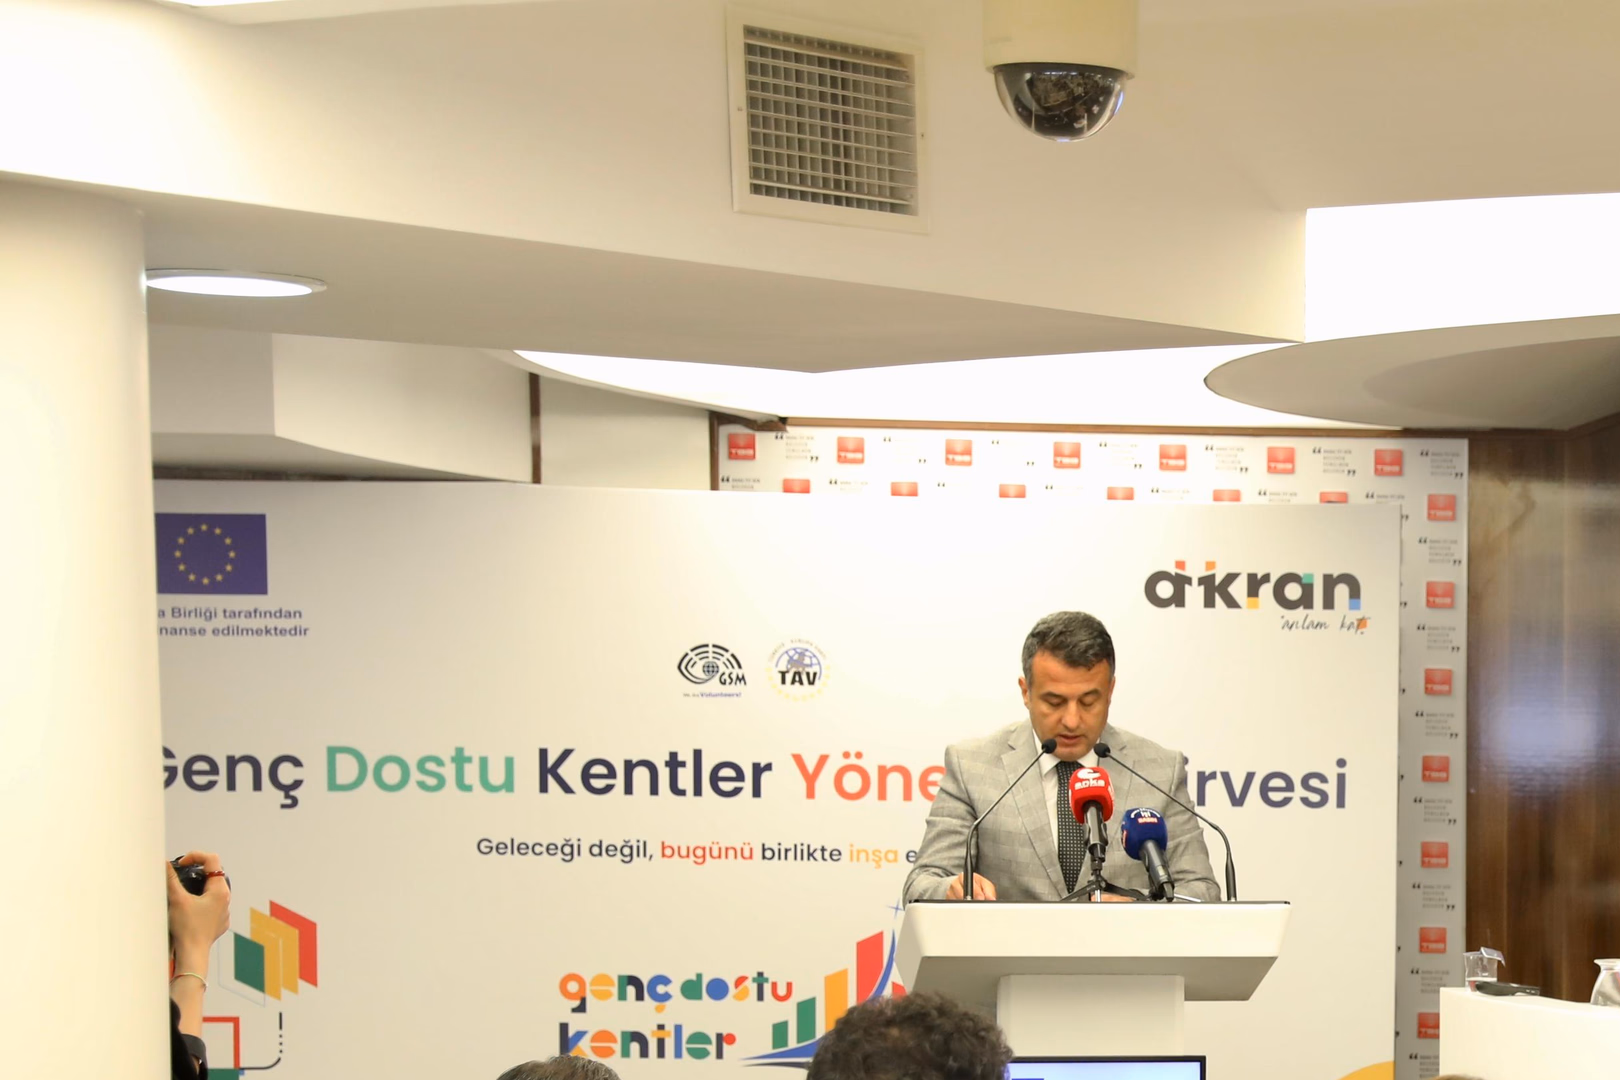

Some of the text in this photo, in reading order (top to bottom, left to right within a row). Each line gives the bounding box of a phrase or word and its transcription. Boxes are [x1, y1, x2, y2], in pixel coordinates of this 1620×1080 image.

[1144, 560, 1361, 611] akran
[159, 625, 310, 637] nanse edilmektedir
[171, 607, 217, 622] Birliği
[222, 607, 303, 619] tarafından
[719, 671, 747, 686] GSM
[777, 670, 818, 686] TAV
[326, 745, 515, 793] Dostu
[538, 747, 773, 799] Kentler
[1183, 757, 1347, 810] rvesi
[476, 838, 582, 863] Geleceği
[588, 839, 653, 864] değil,
[660, 841, 754, 866] bugünü
[761, 842, 842, 862] birlikte
[849, 843, 899, 869] inşa
[558, 971, 793, 1013] genç dostu
[558, 1022, 737, 1060] kentler
